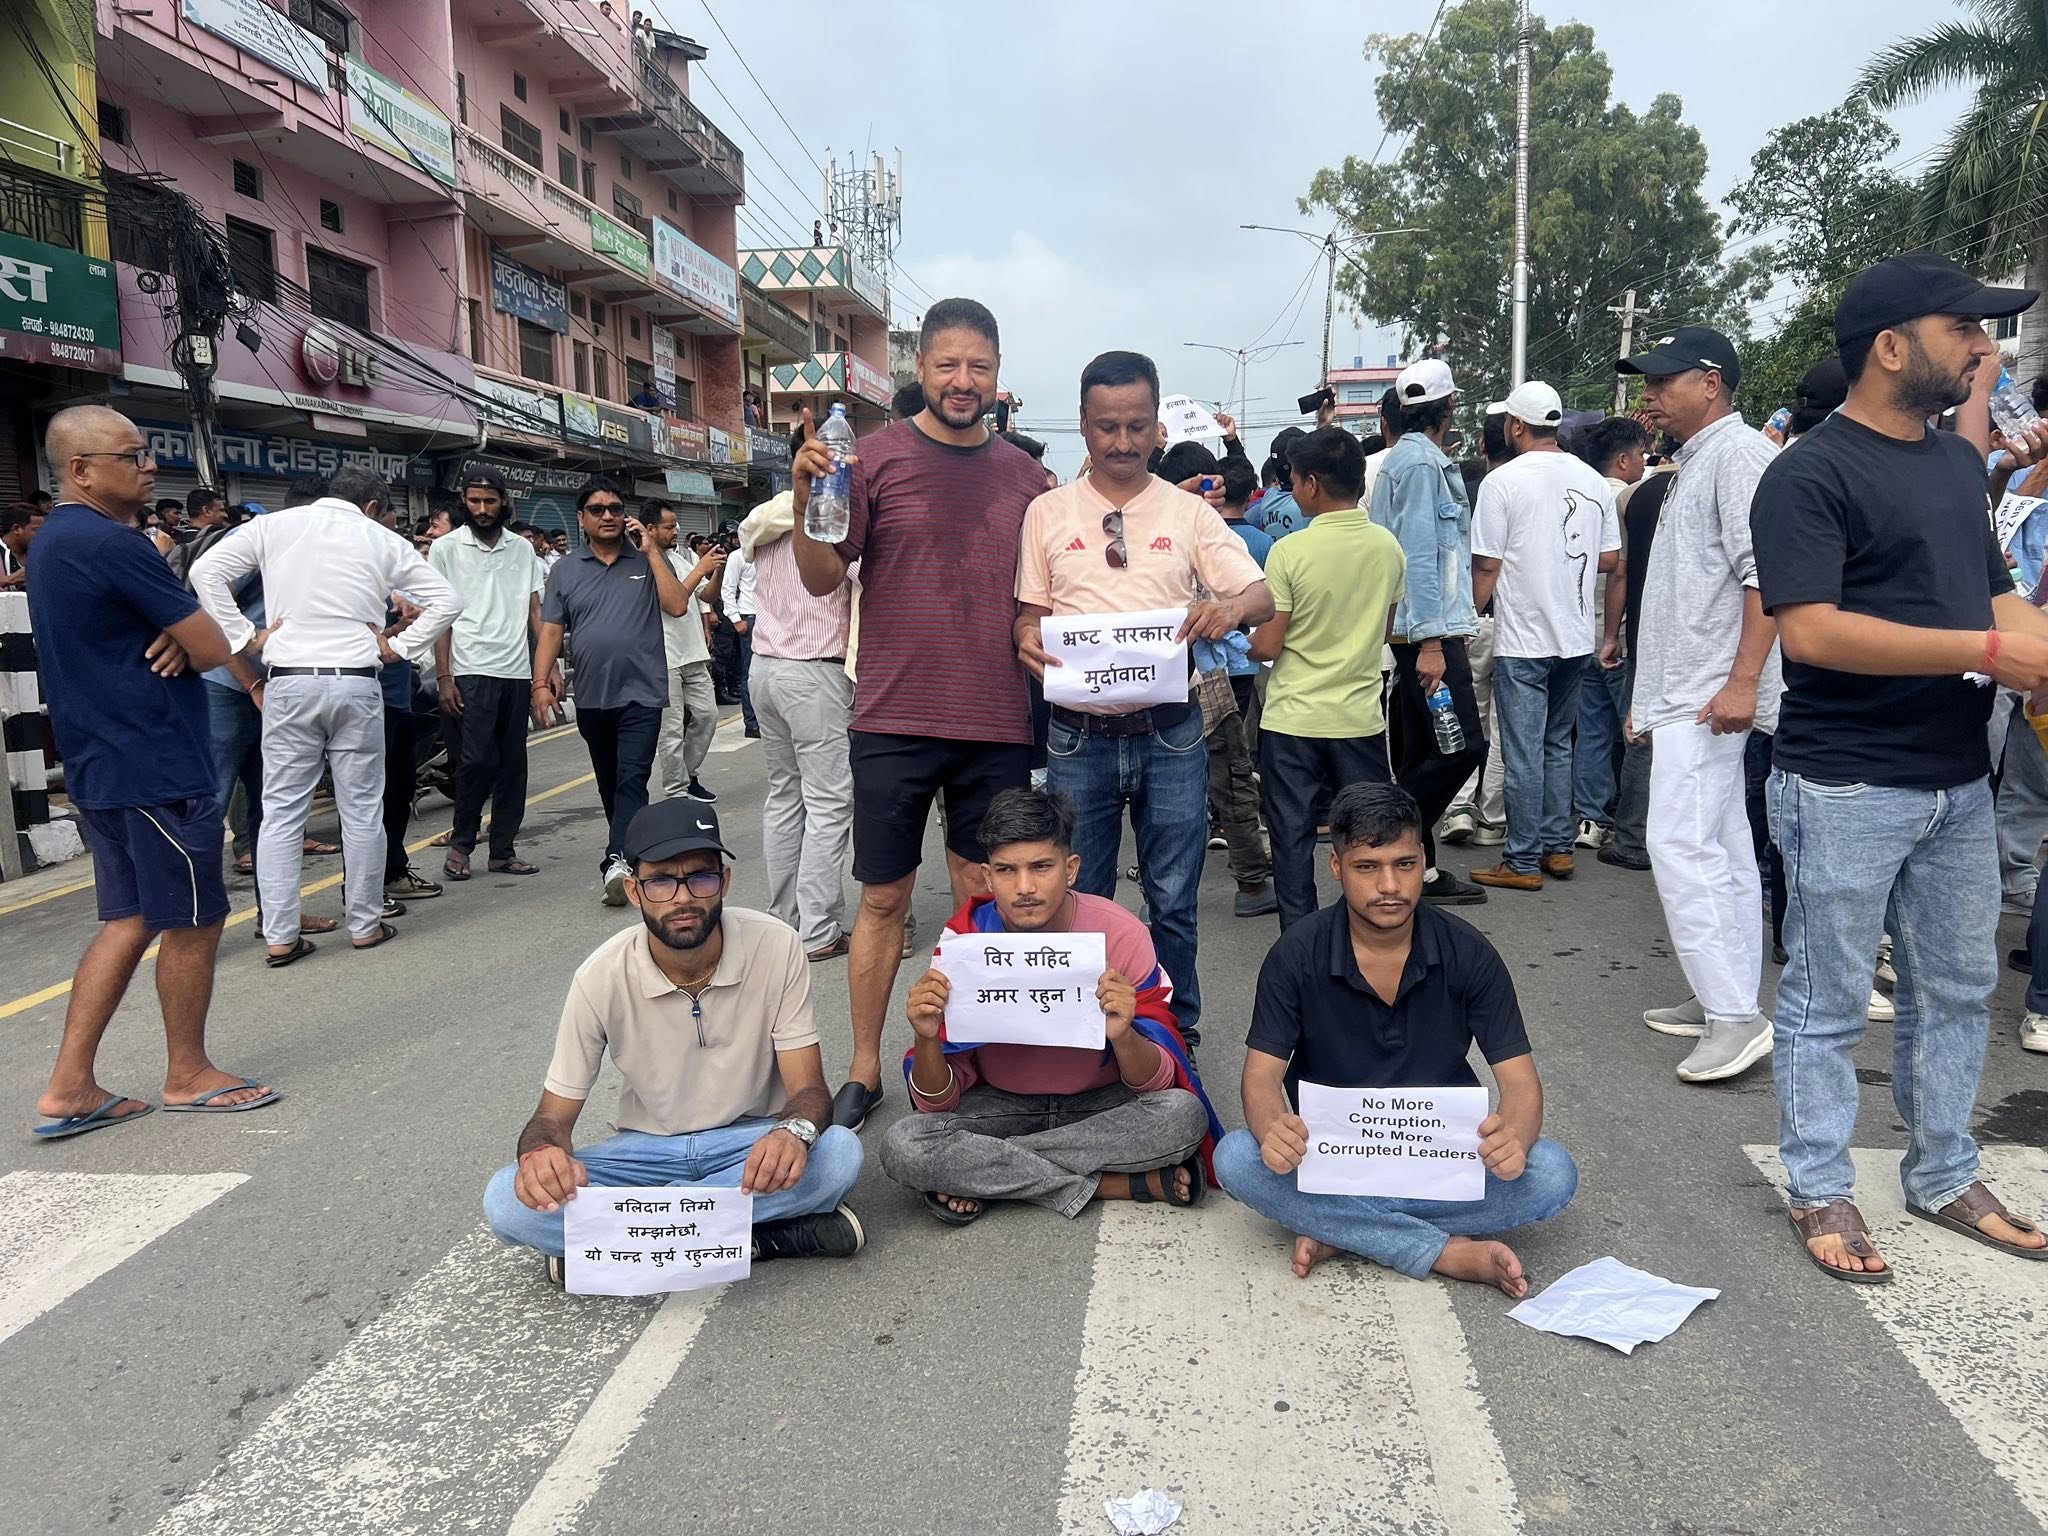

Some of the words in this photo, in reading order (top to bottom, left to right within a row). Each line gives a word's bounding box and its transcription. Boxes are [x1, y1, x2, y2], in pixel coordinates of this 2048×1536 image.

[50, 321, 95, 342] 9848724330
[51, 342, 95, 362] 9848720017
[295, 397, 339, 411] MANAKAMANA
[340, 404, 364, 417] TRADING
[134, 425, 263, 468] काना
[509, 467, 537, 482] HOUSE
[1063, 629, 1102, 646] भ्रष्ट
[1112, 625, 1174, 643] सरकार
[1084, 663, 1156, 694] मुर्दावाद!
[984, 946, 1014, 967] विर
[1024, 945, 1071, 969] सहिद
[976, 989, 1019, 1003] अमर
[1028, 988, 1066, 1013] रहुन
[1076, 986, 1081, 1002] !
[1362, 1097, 1385, 1110] No
[1391, 1097, 1434, 1111] More
[1349, 1112, 1446, 1130] Corruption,
[1361, 1128, 1385, 1139] No
[1390, 1130, 1433, 1143] More
[1318, 1141, 1402, 1158] Corrupted
[1408, 1145, 1477, 1160] Leaders
[614, 1198, 671, 1214] बलिदान
[680, 1198, 716, 1213] तिम्रो
[584, 1246, 602, 1261] यो
[610, 1250, 643, 1263] चन्द्र
[650, 1247, 677, 1268] सुर्य
[684, 1245, 743, 1268] रहुन्जेल!
